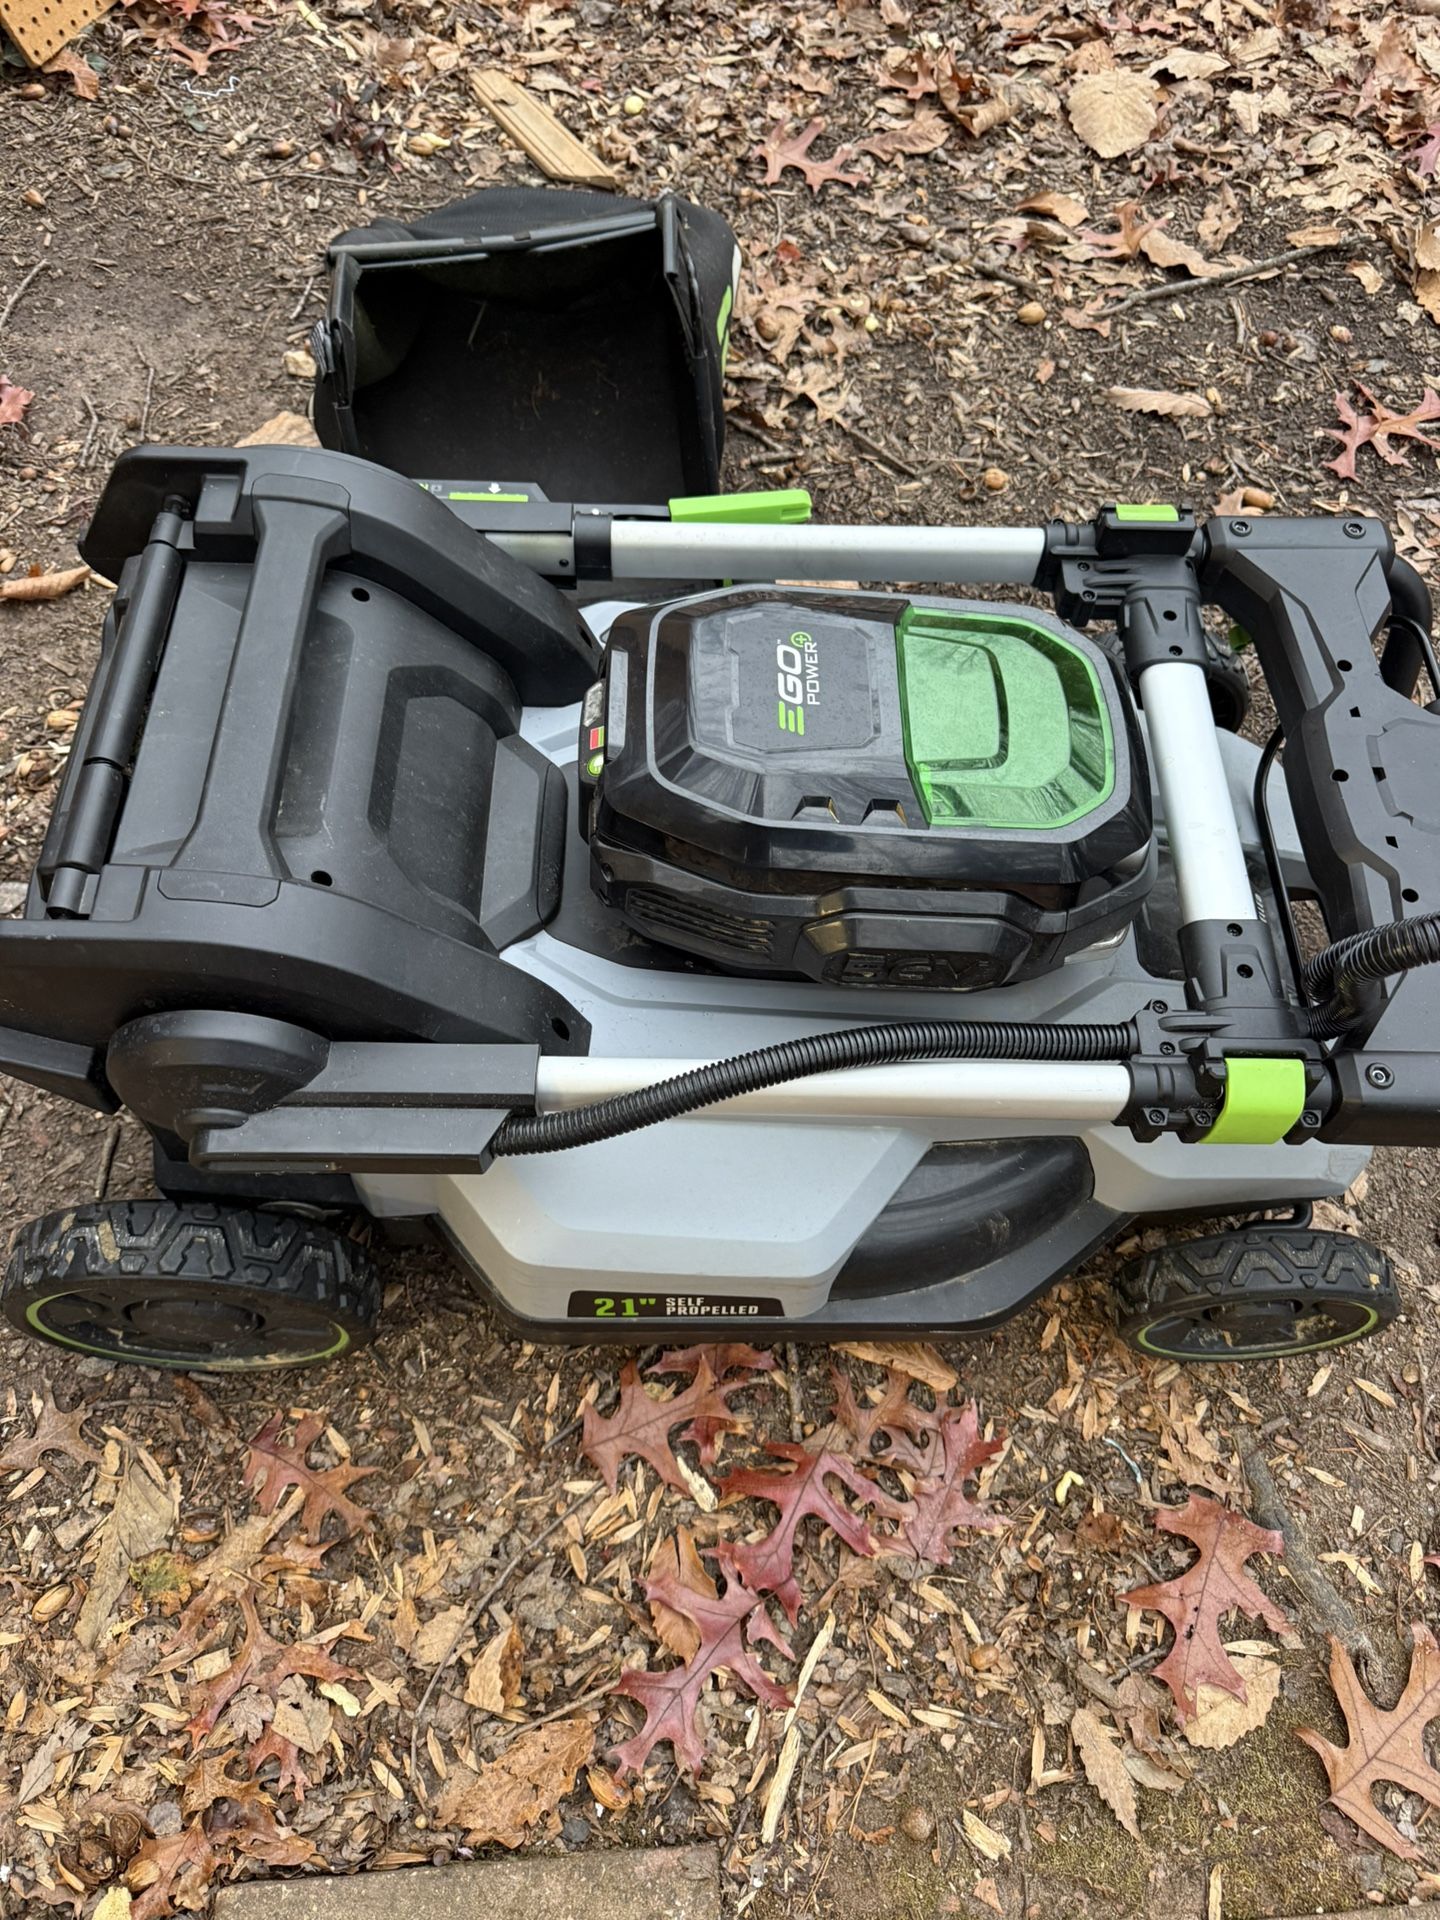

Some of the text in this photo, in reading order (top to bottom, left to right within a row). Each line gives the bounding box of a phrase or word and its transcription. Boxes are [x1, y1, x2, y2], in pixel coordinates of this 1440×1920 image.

[804, 641, 820, 705] POWER
[777, 644, 804, 736] EGO
[593, 1297, 656, 1317] 21"
[665, 1297, 705, 1306] SELF
[666, 1305, 759, 1316] PROPELLED
